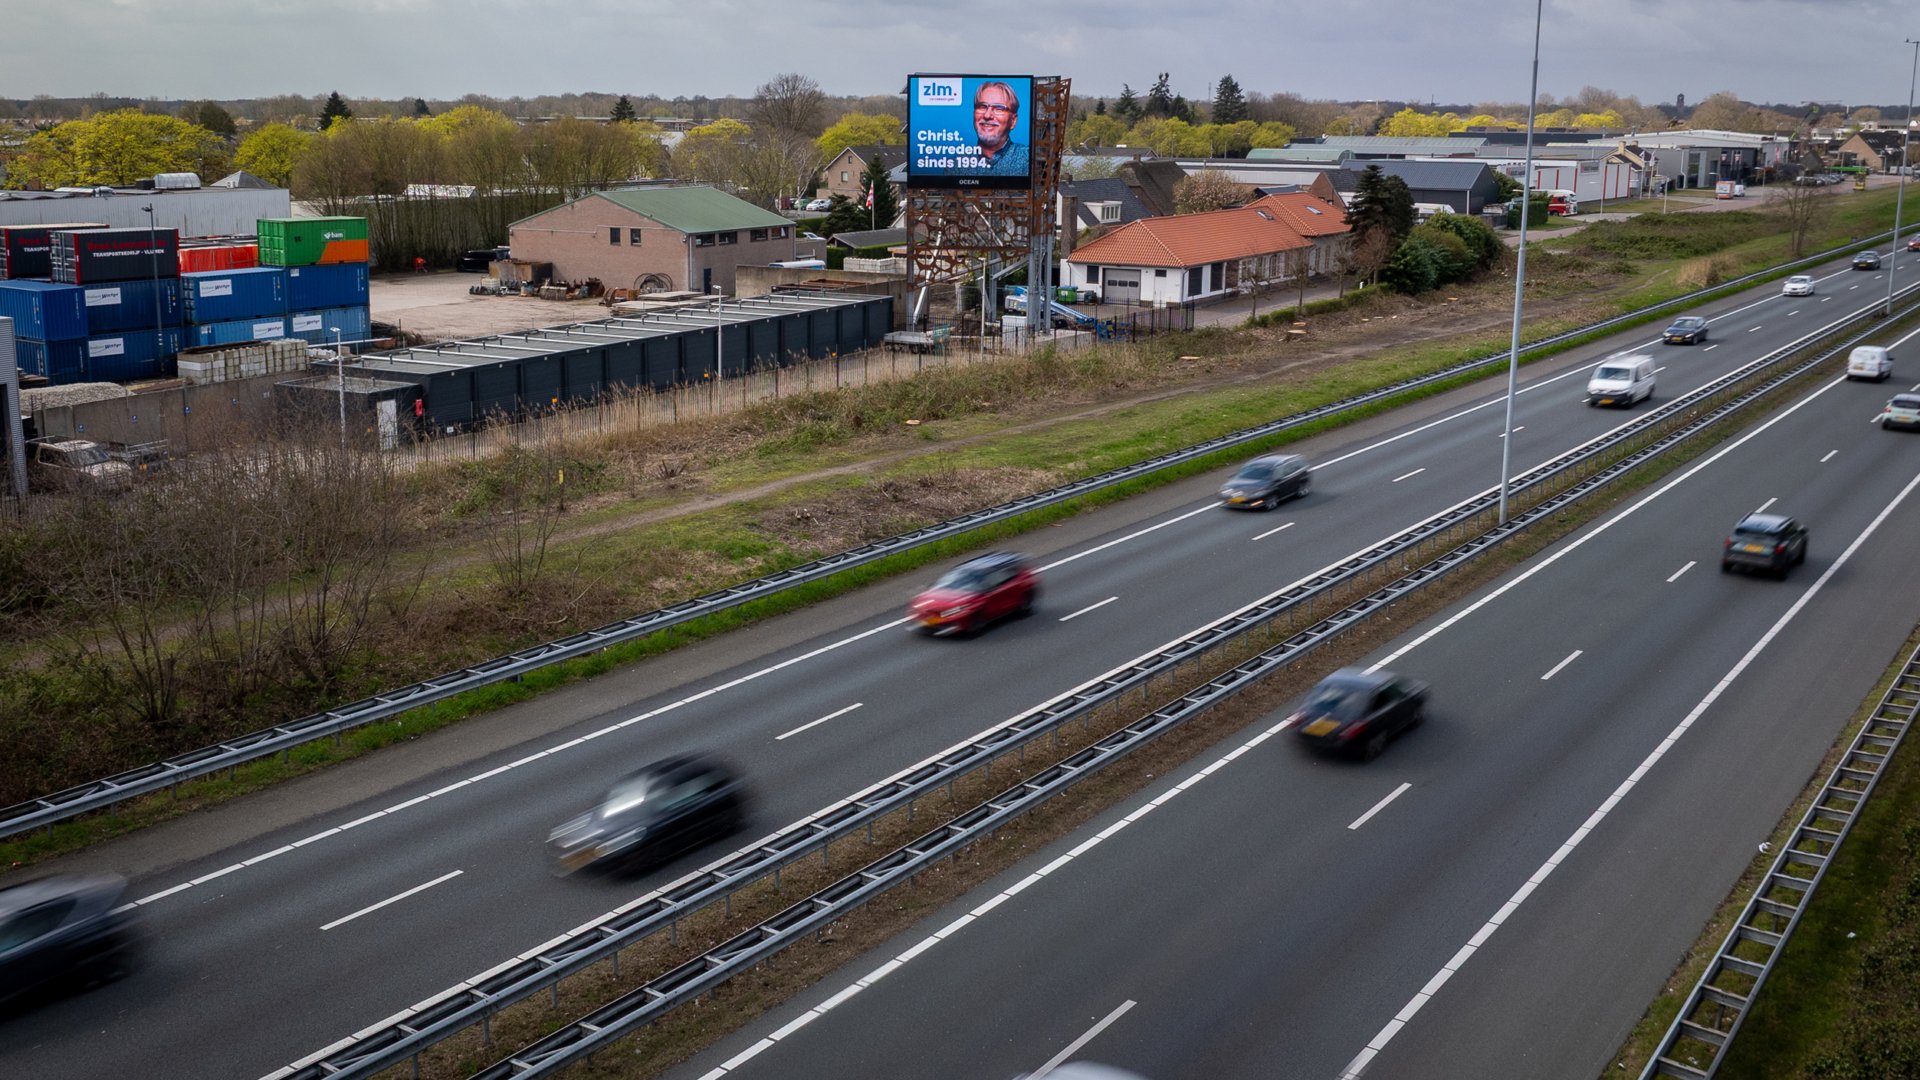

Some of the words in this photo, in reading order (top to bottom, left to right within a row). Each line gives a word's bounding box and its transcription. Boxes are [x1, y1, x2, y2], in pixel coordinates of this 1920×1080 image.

[923, 82, 957, 96] zlm.
[917, 129, 964, 142] Christ.
[917, 144, 982, 155] Tevreden
[917, 156, 954, 168] sinds
[956, 157, 991, 168] 1994.
